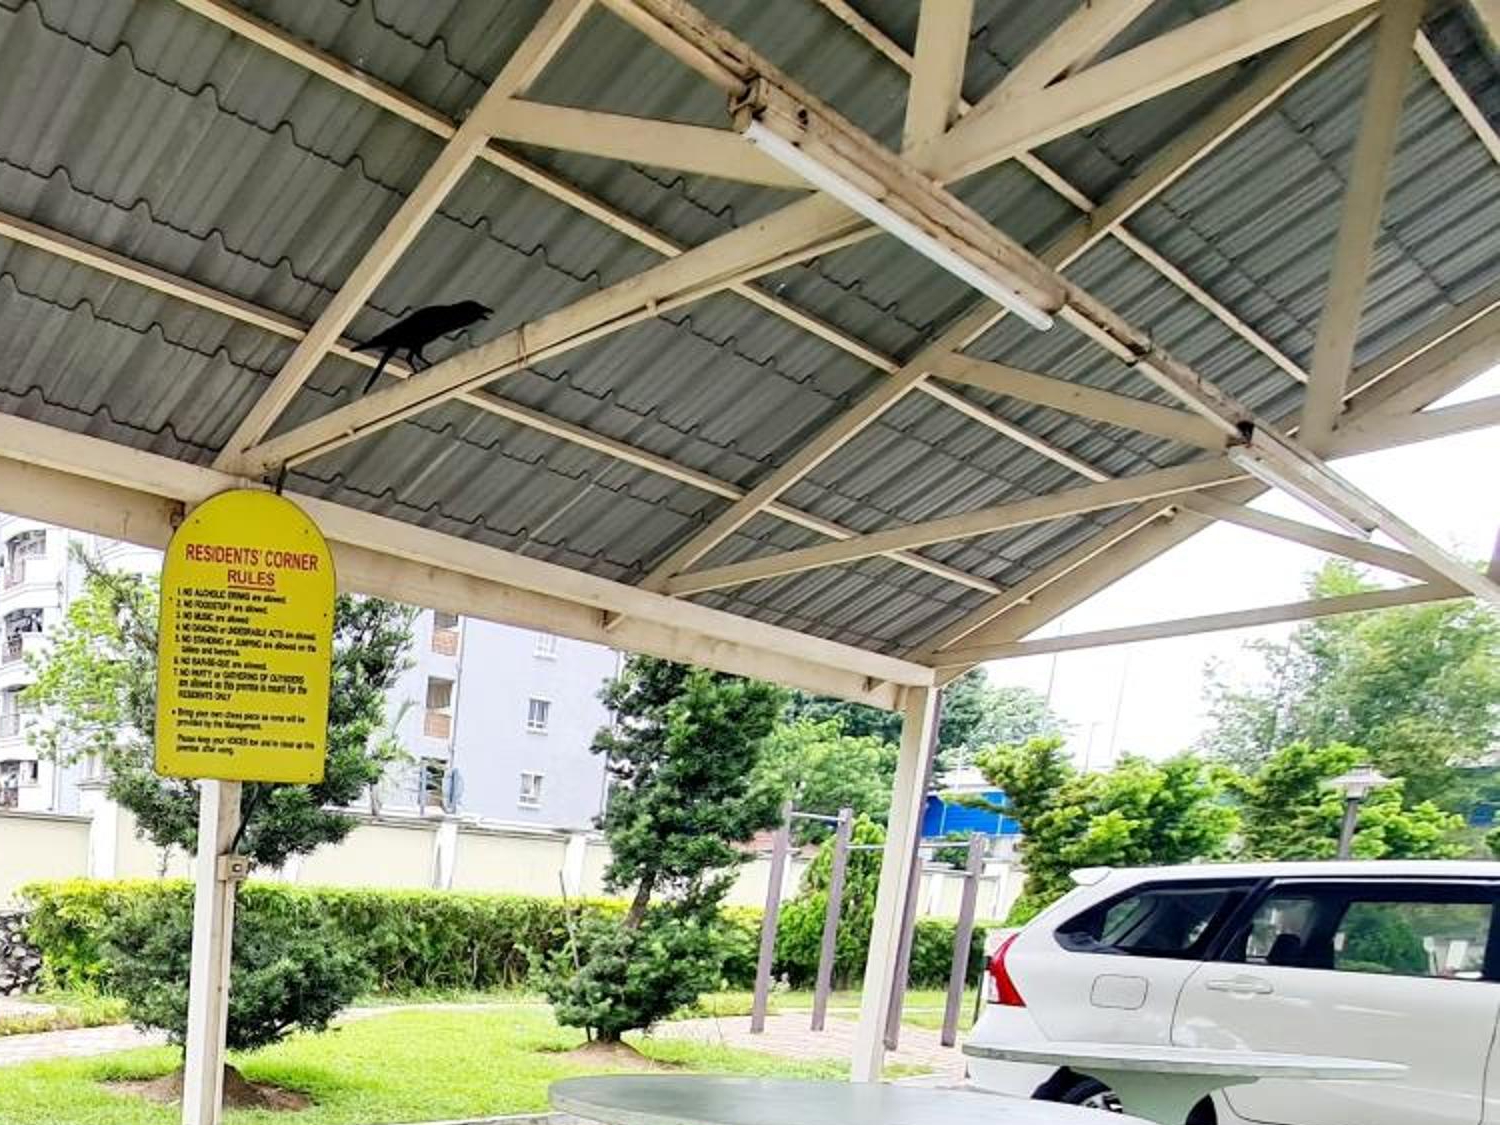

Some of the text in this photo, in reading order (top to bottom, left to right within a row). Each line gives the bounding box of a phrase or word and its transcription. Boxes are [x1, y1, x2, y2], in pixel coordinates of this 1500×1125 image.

[185, 543, 319, 571] RESIDENTS' CORNER
[227, 569, 275, 587] RULES
